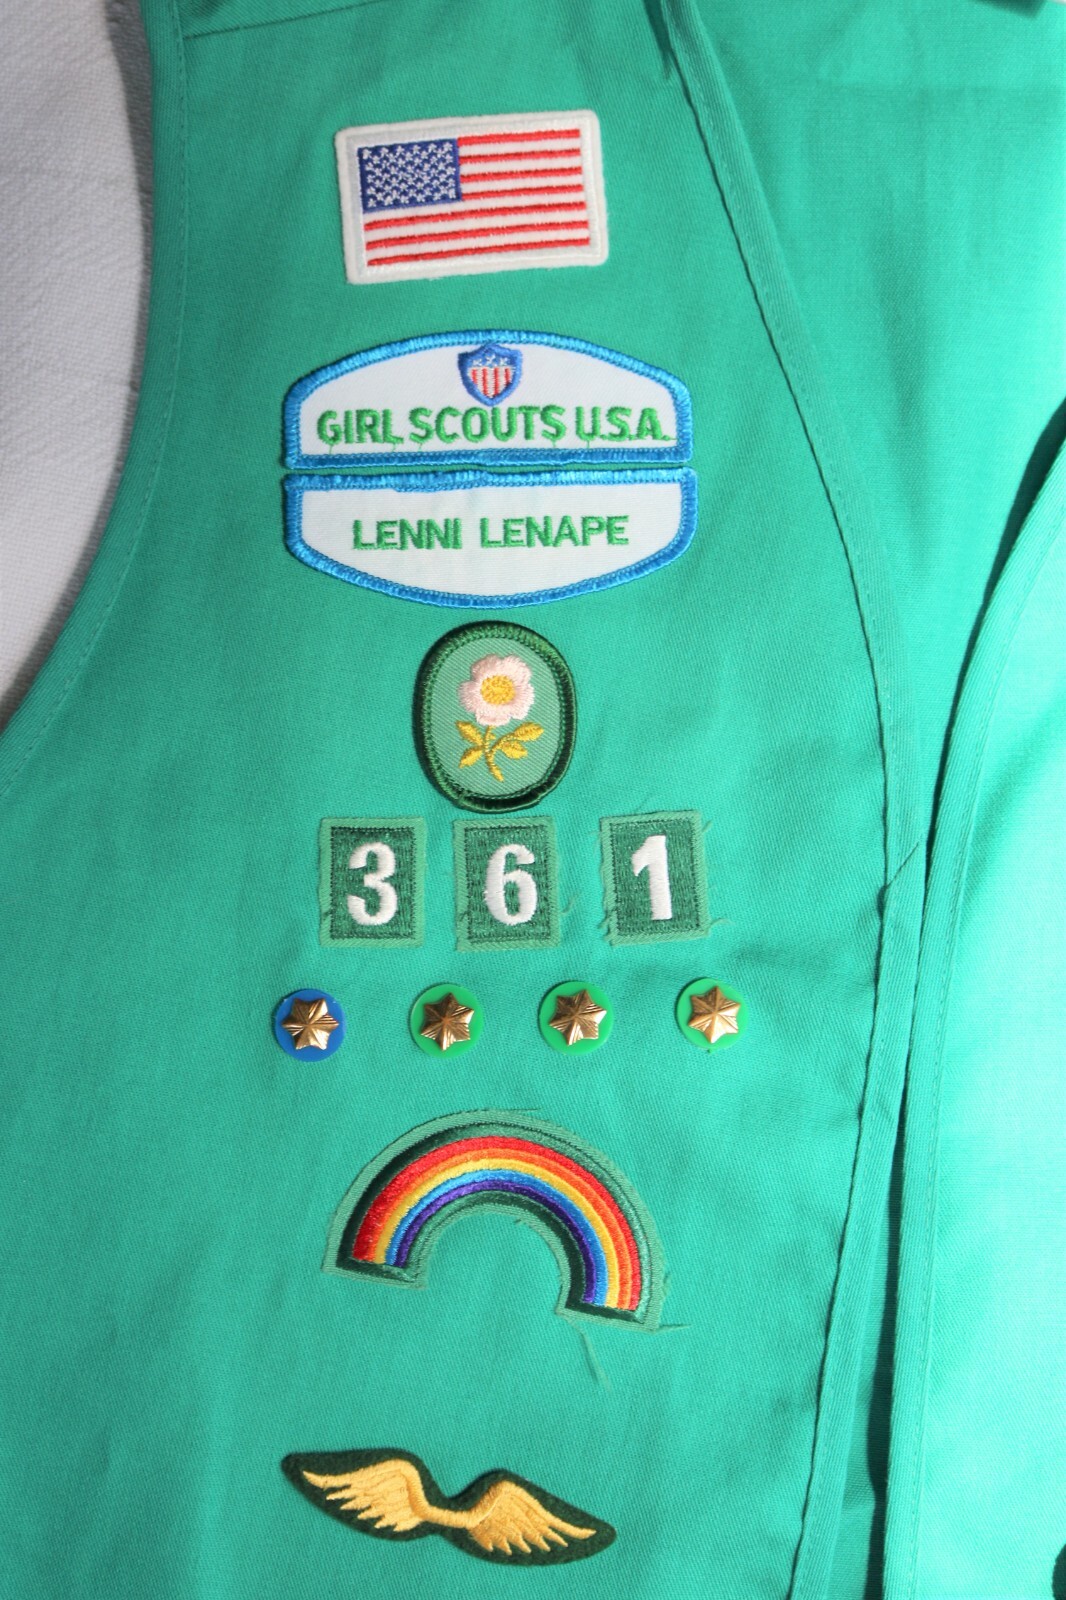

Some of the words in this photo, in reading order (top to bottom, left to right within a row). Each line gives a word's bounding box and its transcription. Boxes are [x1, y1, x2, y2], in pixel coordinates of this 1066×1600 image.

[317, 408, 404, 445] GIRL
[409, 403, 567, 445] SCOUTS
[575, 406, 675, 442] U.S.A.
[352, 517, 464, 551] LENNI
[479, 515, 630, 550] LENAPE
